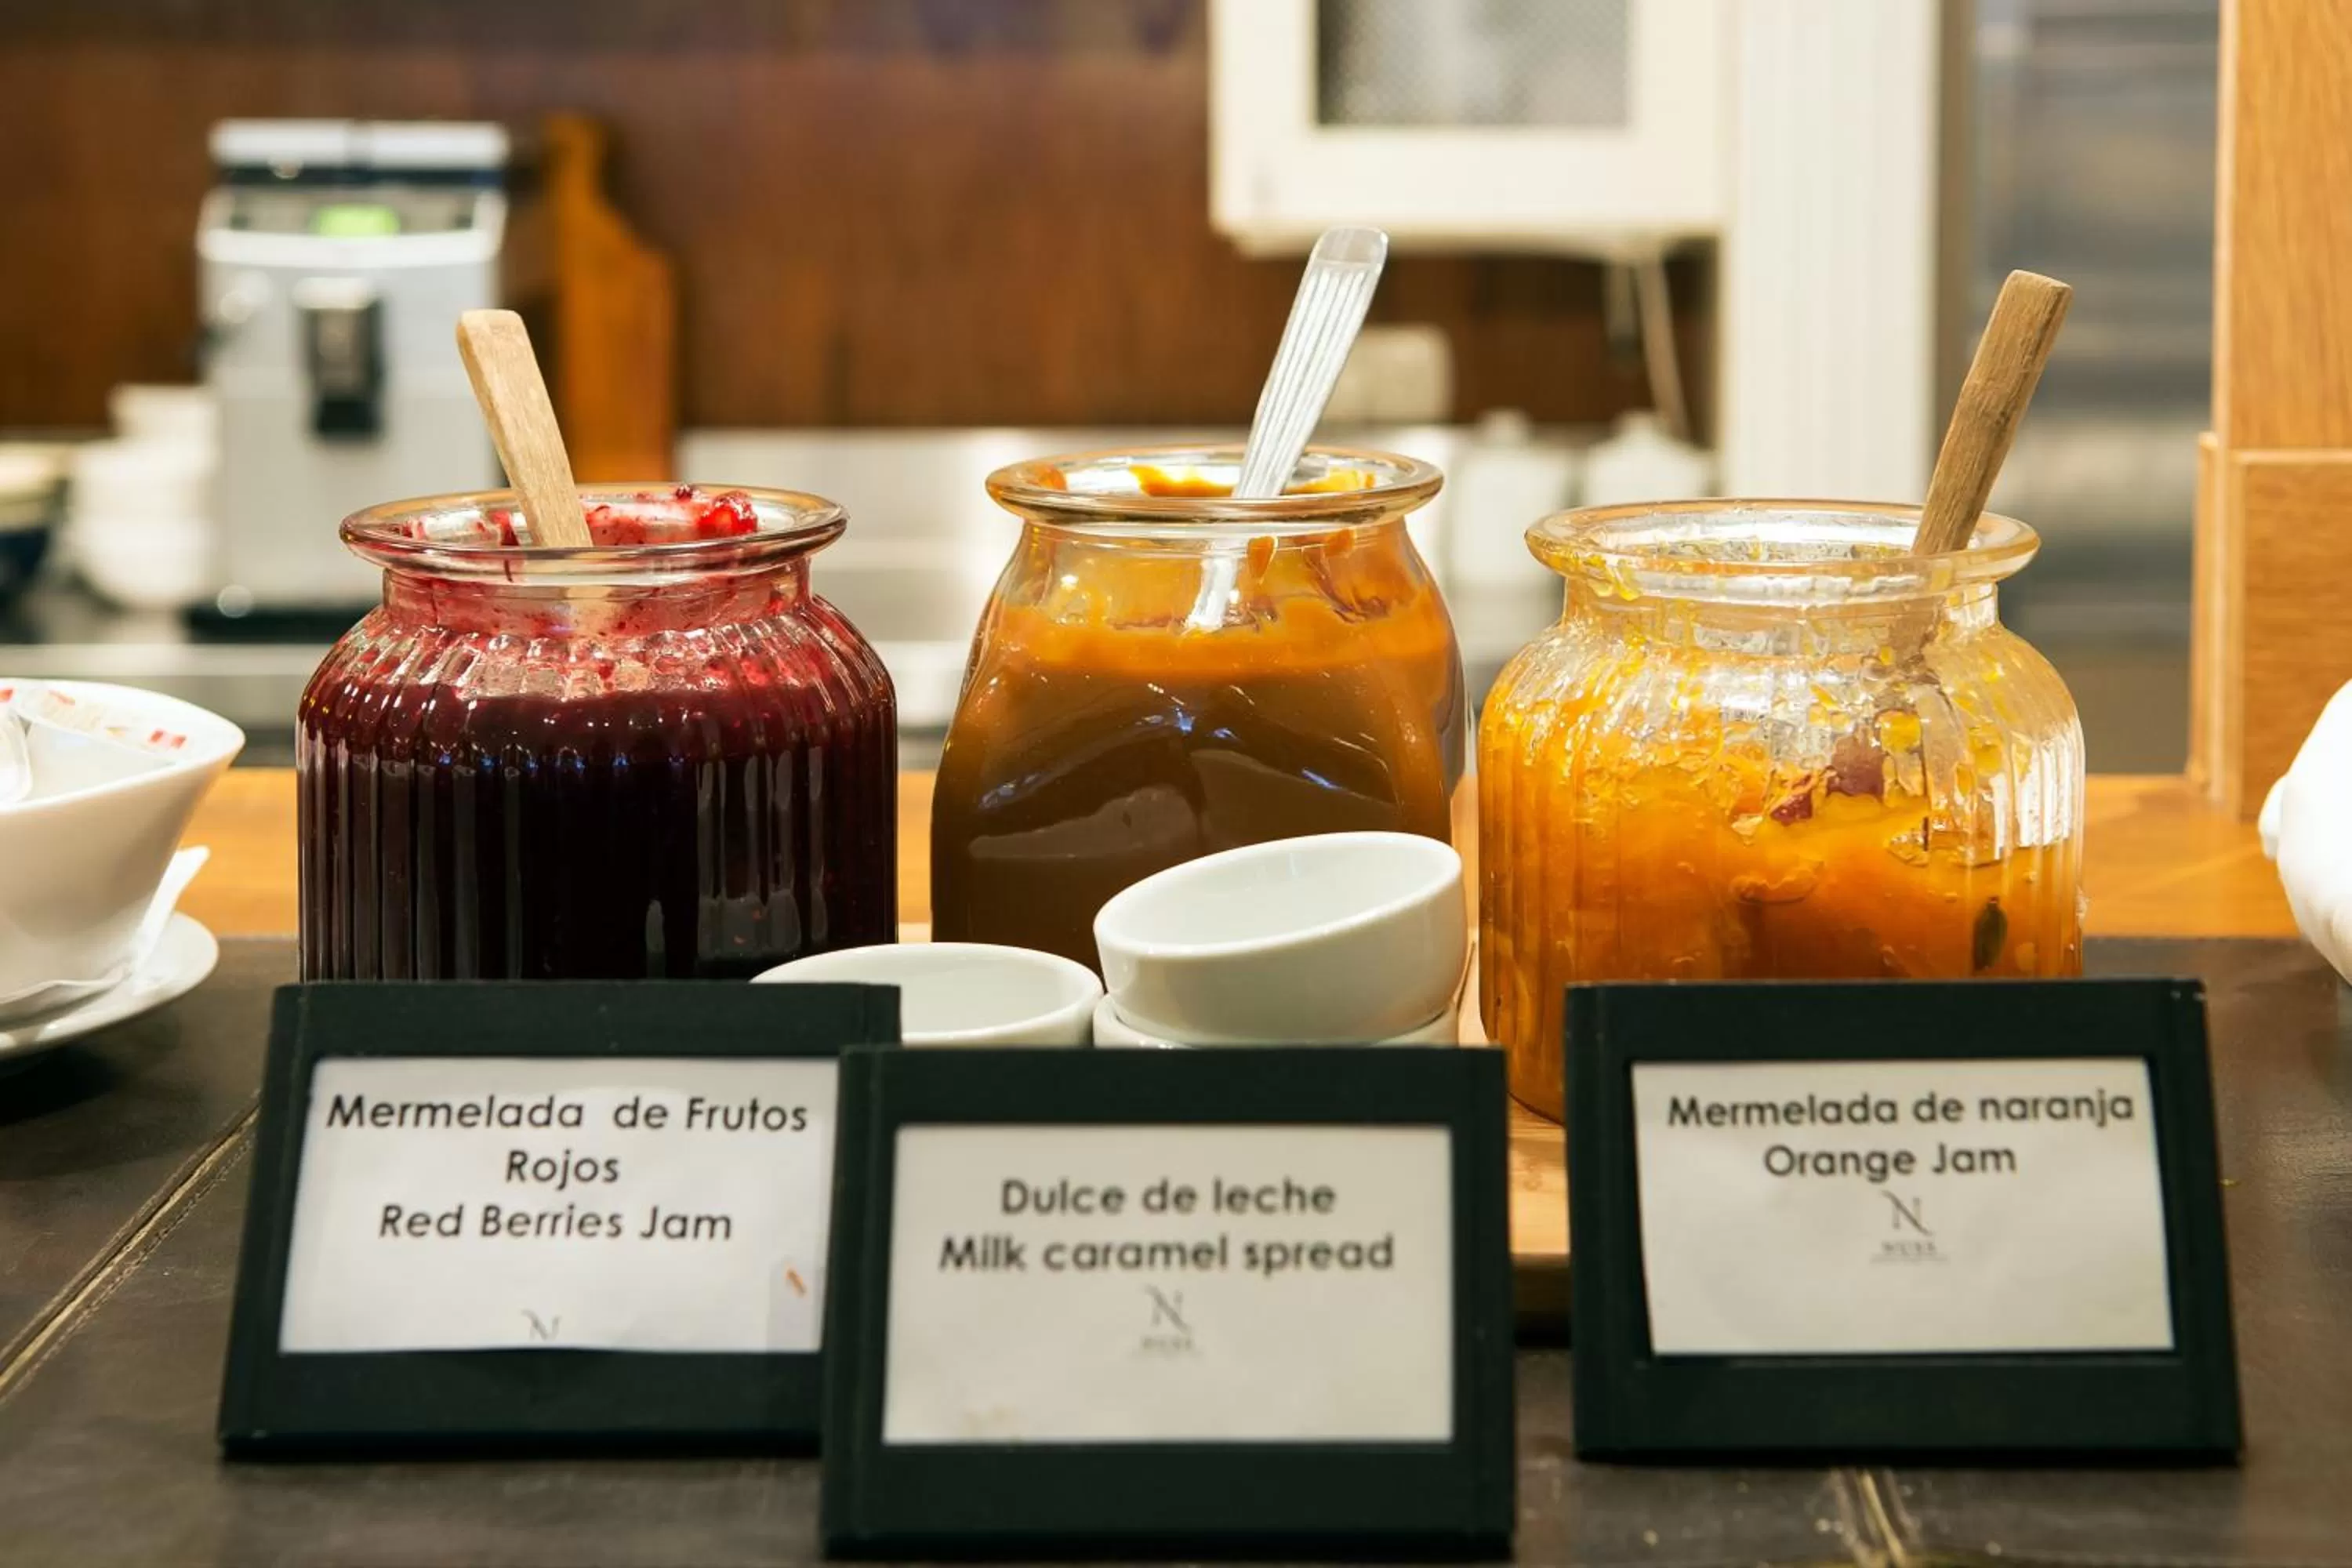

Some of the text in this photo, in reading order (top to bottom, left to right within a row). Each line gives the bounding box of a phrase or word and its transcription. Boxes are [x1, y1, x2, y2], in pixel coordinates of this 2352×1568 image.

[325, 1094, 808, 1132] Mermelada de Frutos
[1668, 1087, 2135, 1129] Mermelada de naranja
[506, 1149, 619, 1192] Rojos
[1763, 1142, 2016, 1184] Orange Jam
[1001, 1178, 1337, 1215] Dulce de leche
[379, 1203, 731, 1240] Red Berries Jam
[939, 1233, 1395, 1277] Milk caramel spread
